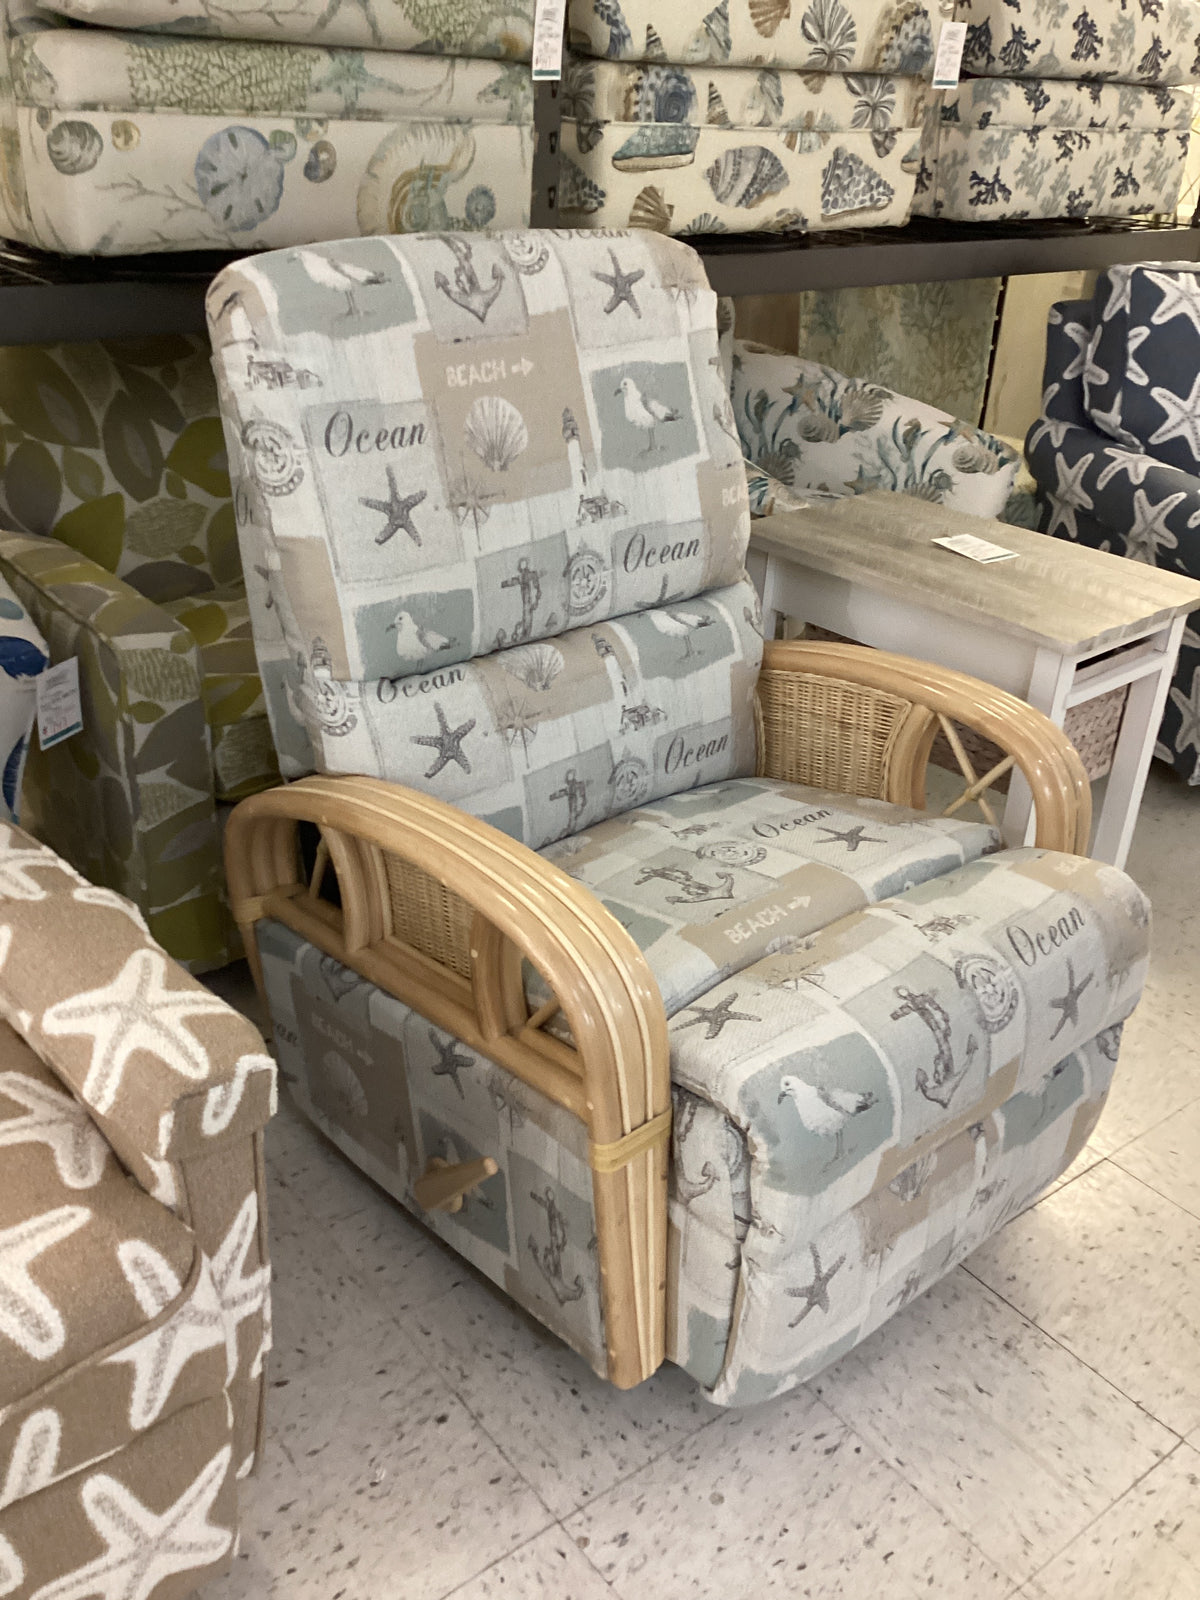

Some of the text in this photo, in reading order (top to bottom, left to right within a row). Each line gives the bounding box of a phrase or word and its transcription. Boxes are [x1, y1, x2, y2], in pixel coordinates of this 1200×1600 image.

[446, 359, 507, 387] BEACH
[325, 410, 426, 457] Ocean
[624, 533, 700, 573] Ocean
[376, 668, 467, 704] Ocean
[664, 734, 728, 774] Ocean
[751, 808, 832, 838] Ocean
[723, 905, 788, 944] BEACH
[1005, 907, 1085, 967] Ocean
